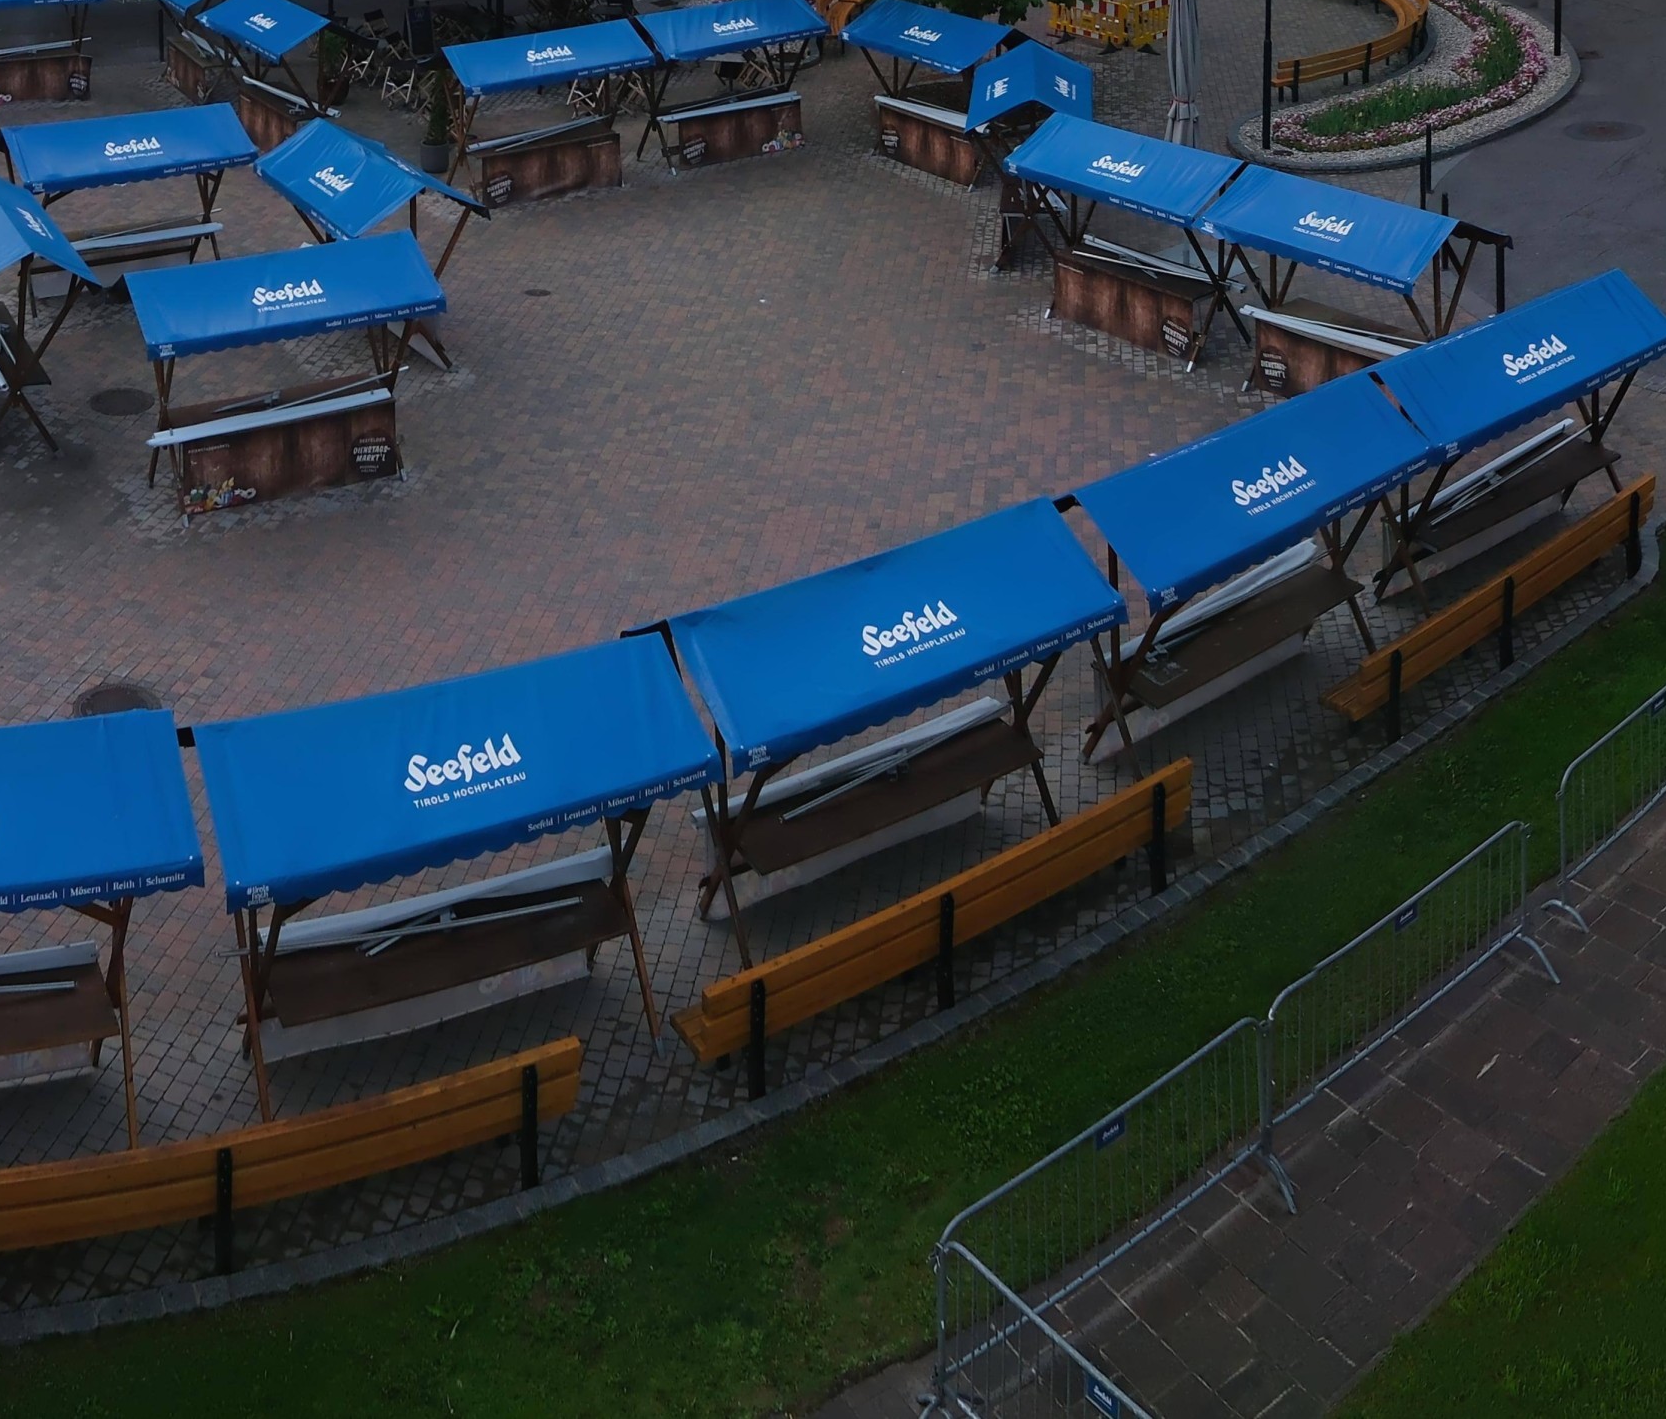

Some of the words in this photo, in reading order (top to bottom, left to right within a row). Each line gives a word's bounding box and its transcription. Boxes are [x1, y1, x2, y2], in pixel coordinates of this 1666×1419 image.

[713, 18, 755, 33] Seefeld
[904, 26, 943, 42] Seefeld
[527, 45, 573, 62] Seefeld
[104, 136, 161, 156] Seefeld
[1093, 155, 1146, 177] Seefeld
[1300, 211, 1354, 236] Seefeld
[253, 279, 324, 306] Seefeld
[1503, 335, 1568, 376] Seefeld
[353, 444, 392, 456] DIENSTAGS-
[355, 452, 386, 462] MARKT'L
[1233, 456, 1308, 506] Seefeld
[1247, 502, 1271, 516] TIROLS
[1272, 479, 1317, 506] HOCHPLATEAU
[863, 600, 958, 655] Seefeld
[874, 651, 905, 669] TIROLS
[907, 627, 966, 657] HOCHPLATEAU
[975, 665, 995, 679] Seefeld
[1002, 650, 1029, 667] Leutasch
[1036, 637, 1059, 653] Mösern
[1065, 628, 1081, 641] Reith
[1087, 614, 1115, 631] Scharnitz
[404, 734, 522, 792] Seefeld
[413, 794, 450, 810] TIROLS
[453, 771, 527, 798] HOCHPLATEAU
[529, 818, 554, 832] Seefeld
[564, 806, 597, 821] Leutasch
[607, 794, 635, 808] Mösern
[645, 783, 665, 797] Reith
[673, 768, 707, 783] Scharnitz
[20, 890, 58, 903] Leutasch
[70, 884, 101, 897] Mösern
[113, 879, 135, 891] Reith
[146, 872, 186, 886] Scharnitz
